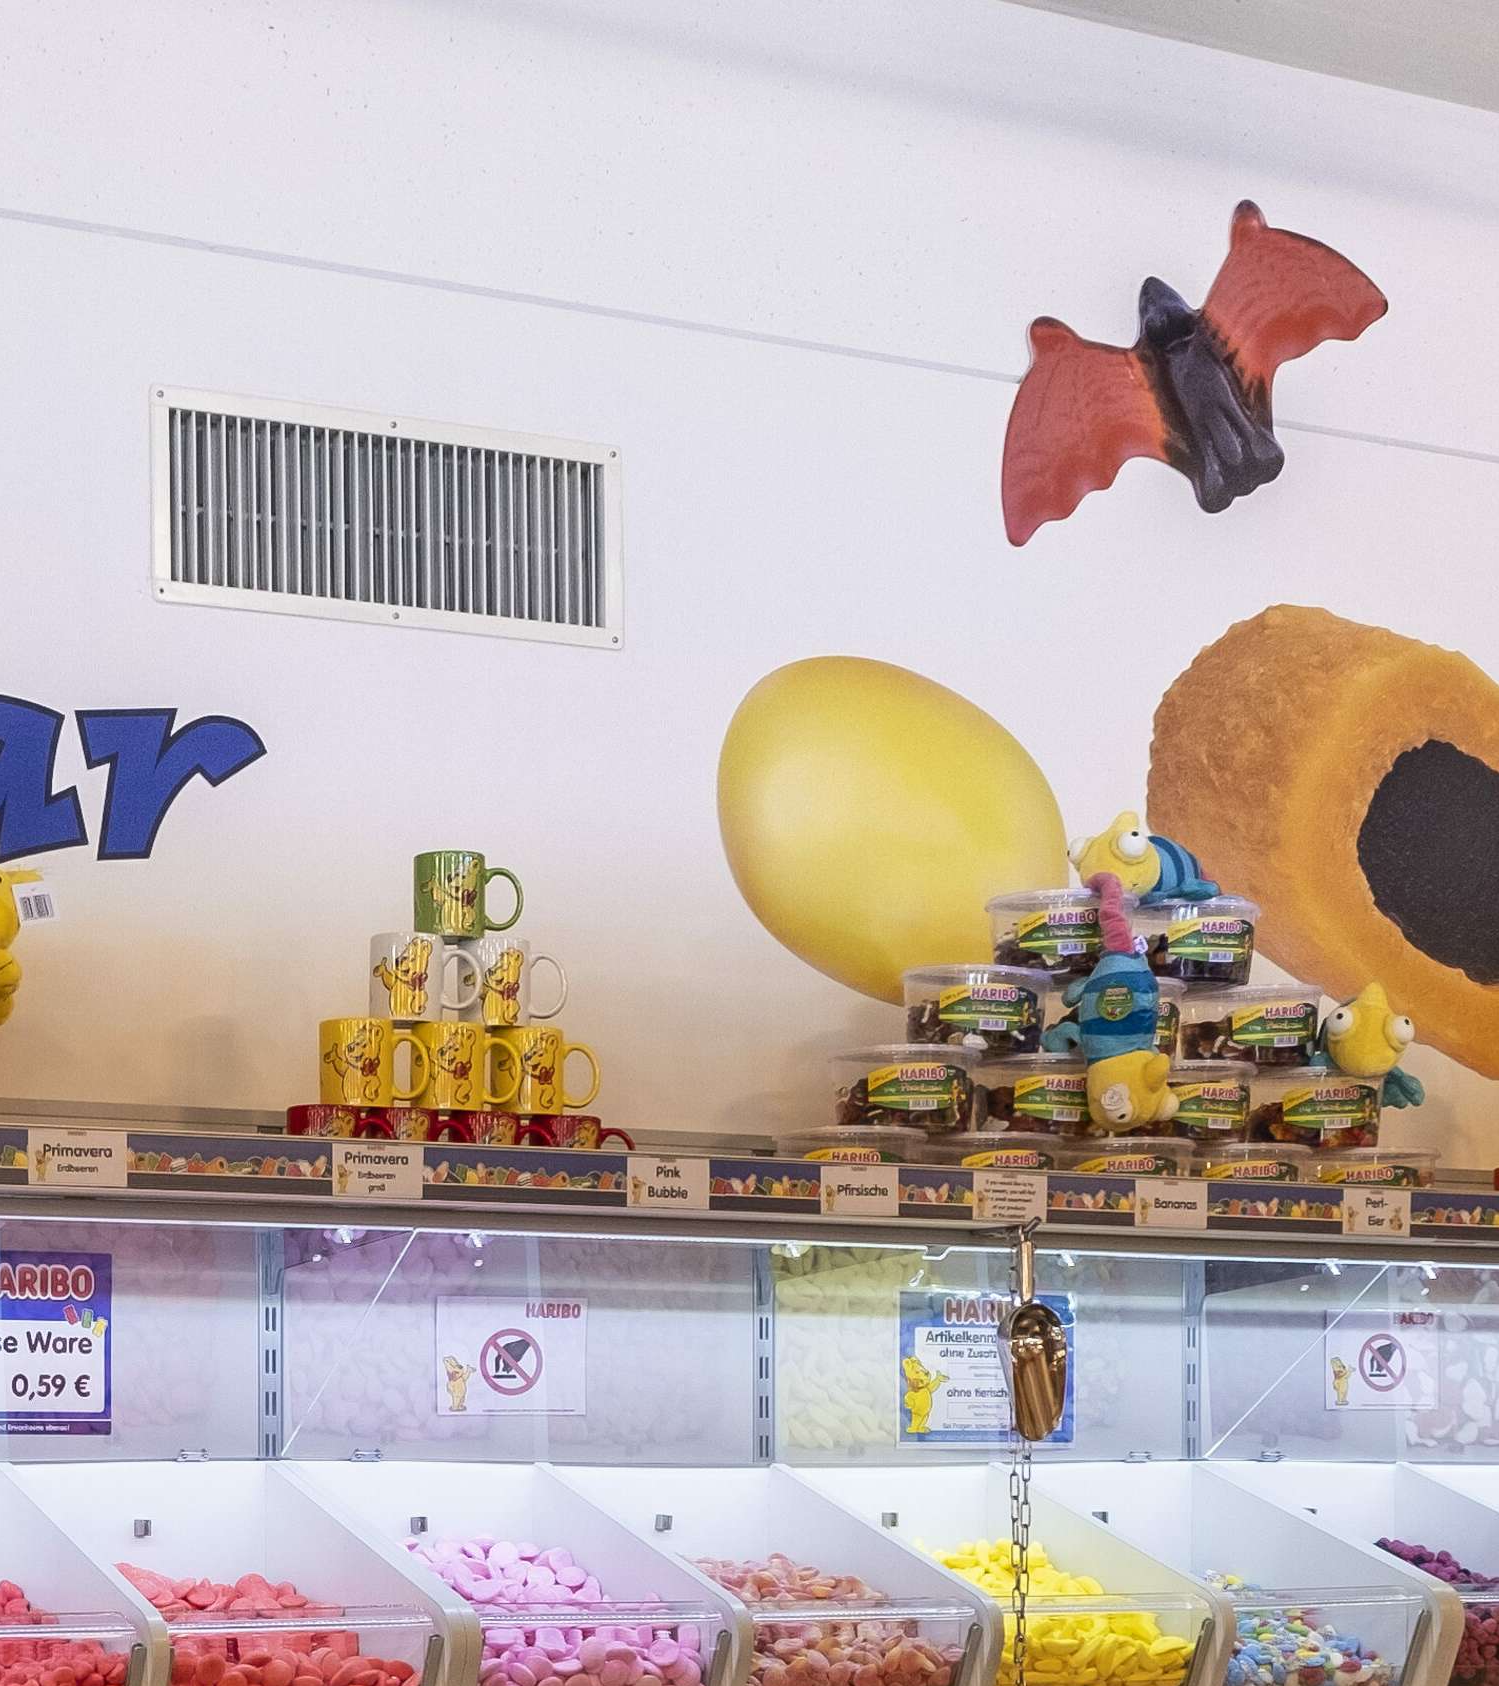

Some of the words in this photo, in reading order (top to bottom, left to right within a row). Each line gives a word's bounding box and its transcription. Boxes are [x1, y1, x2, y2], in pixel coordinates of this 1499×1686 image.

[1048, 911, 1095, 925] HARIBO
[1201, 921, 1243, 933] HARIBO
[971, 987, 1018, 1001] HARIBO
[1265, 1005, 1305, 1018] HARIBO
[899, 1067, 947, 1080] HARIBO
[1202, 1087, 1239, 1099] HARIBO
[1314, 1087, 1360, 1099] HARIBO
[43, 1143, 112, 1158] Primavera
[831, 1151, 881, 1162] HARIBO
[344, 1151, 408, 1165] Primavera
[993, 1154, 1038, 1166] HARIBO
[57, 1163, 98, 1173] Erdbeeren
[656, 1165, 681, 1179] Pink
[1106, 1159, 1155, 1172] HARIBO
[1233, 1164, 1279, 1177] HARIBO
[1345, 1168, 1394, 1180] HARIBO
[647, 1186, 688, 1200] Bubble
[837, 1183, 888, 1197] Pfirsische
[1154, 1198, 1197, 1211] Bananas
[525, 1302, 582, 1319] HARIBO
[945, 1298, 1010, 1325] HARI
[26, 1331, 93, 1354] Ware
[939, 1347, 964, 1358] ohne
[11, 1373, 66, 1401] 0,59
[74, 1375, 91, 1397] €
[947, 1388, 971, 1398] ohne
